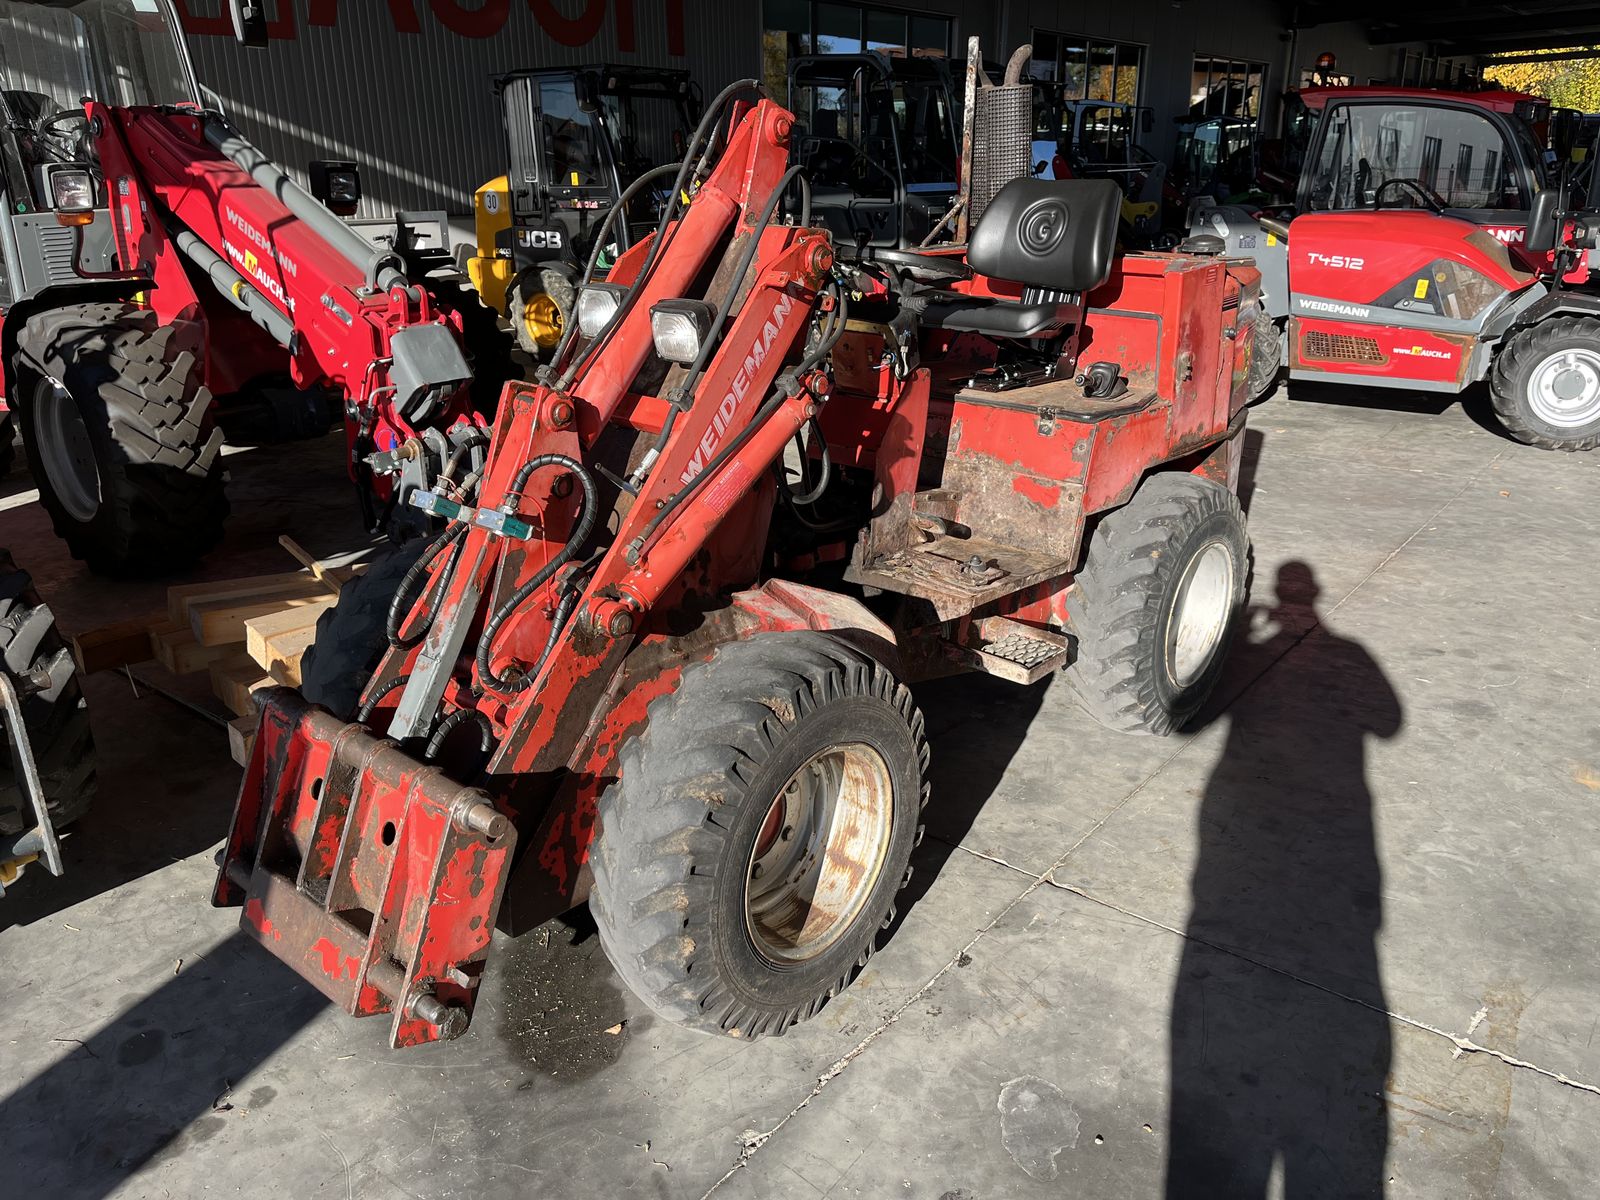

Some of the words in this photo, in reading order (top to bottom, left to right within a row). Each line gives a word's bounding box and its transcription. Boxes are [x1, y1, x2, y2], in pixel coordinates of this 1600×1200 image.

[486, 194, 497, 209] 30
[226, 206, 297, 277] WEIDEMANN
[518, 230, 562, 249] JCB
[1308, 252, 1364, 270] T4512
[1299, 299, 1370, 318] WEIDEMANN
